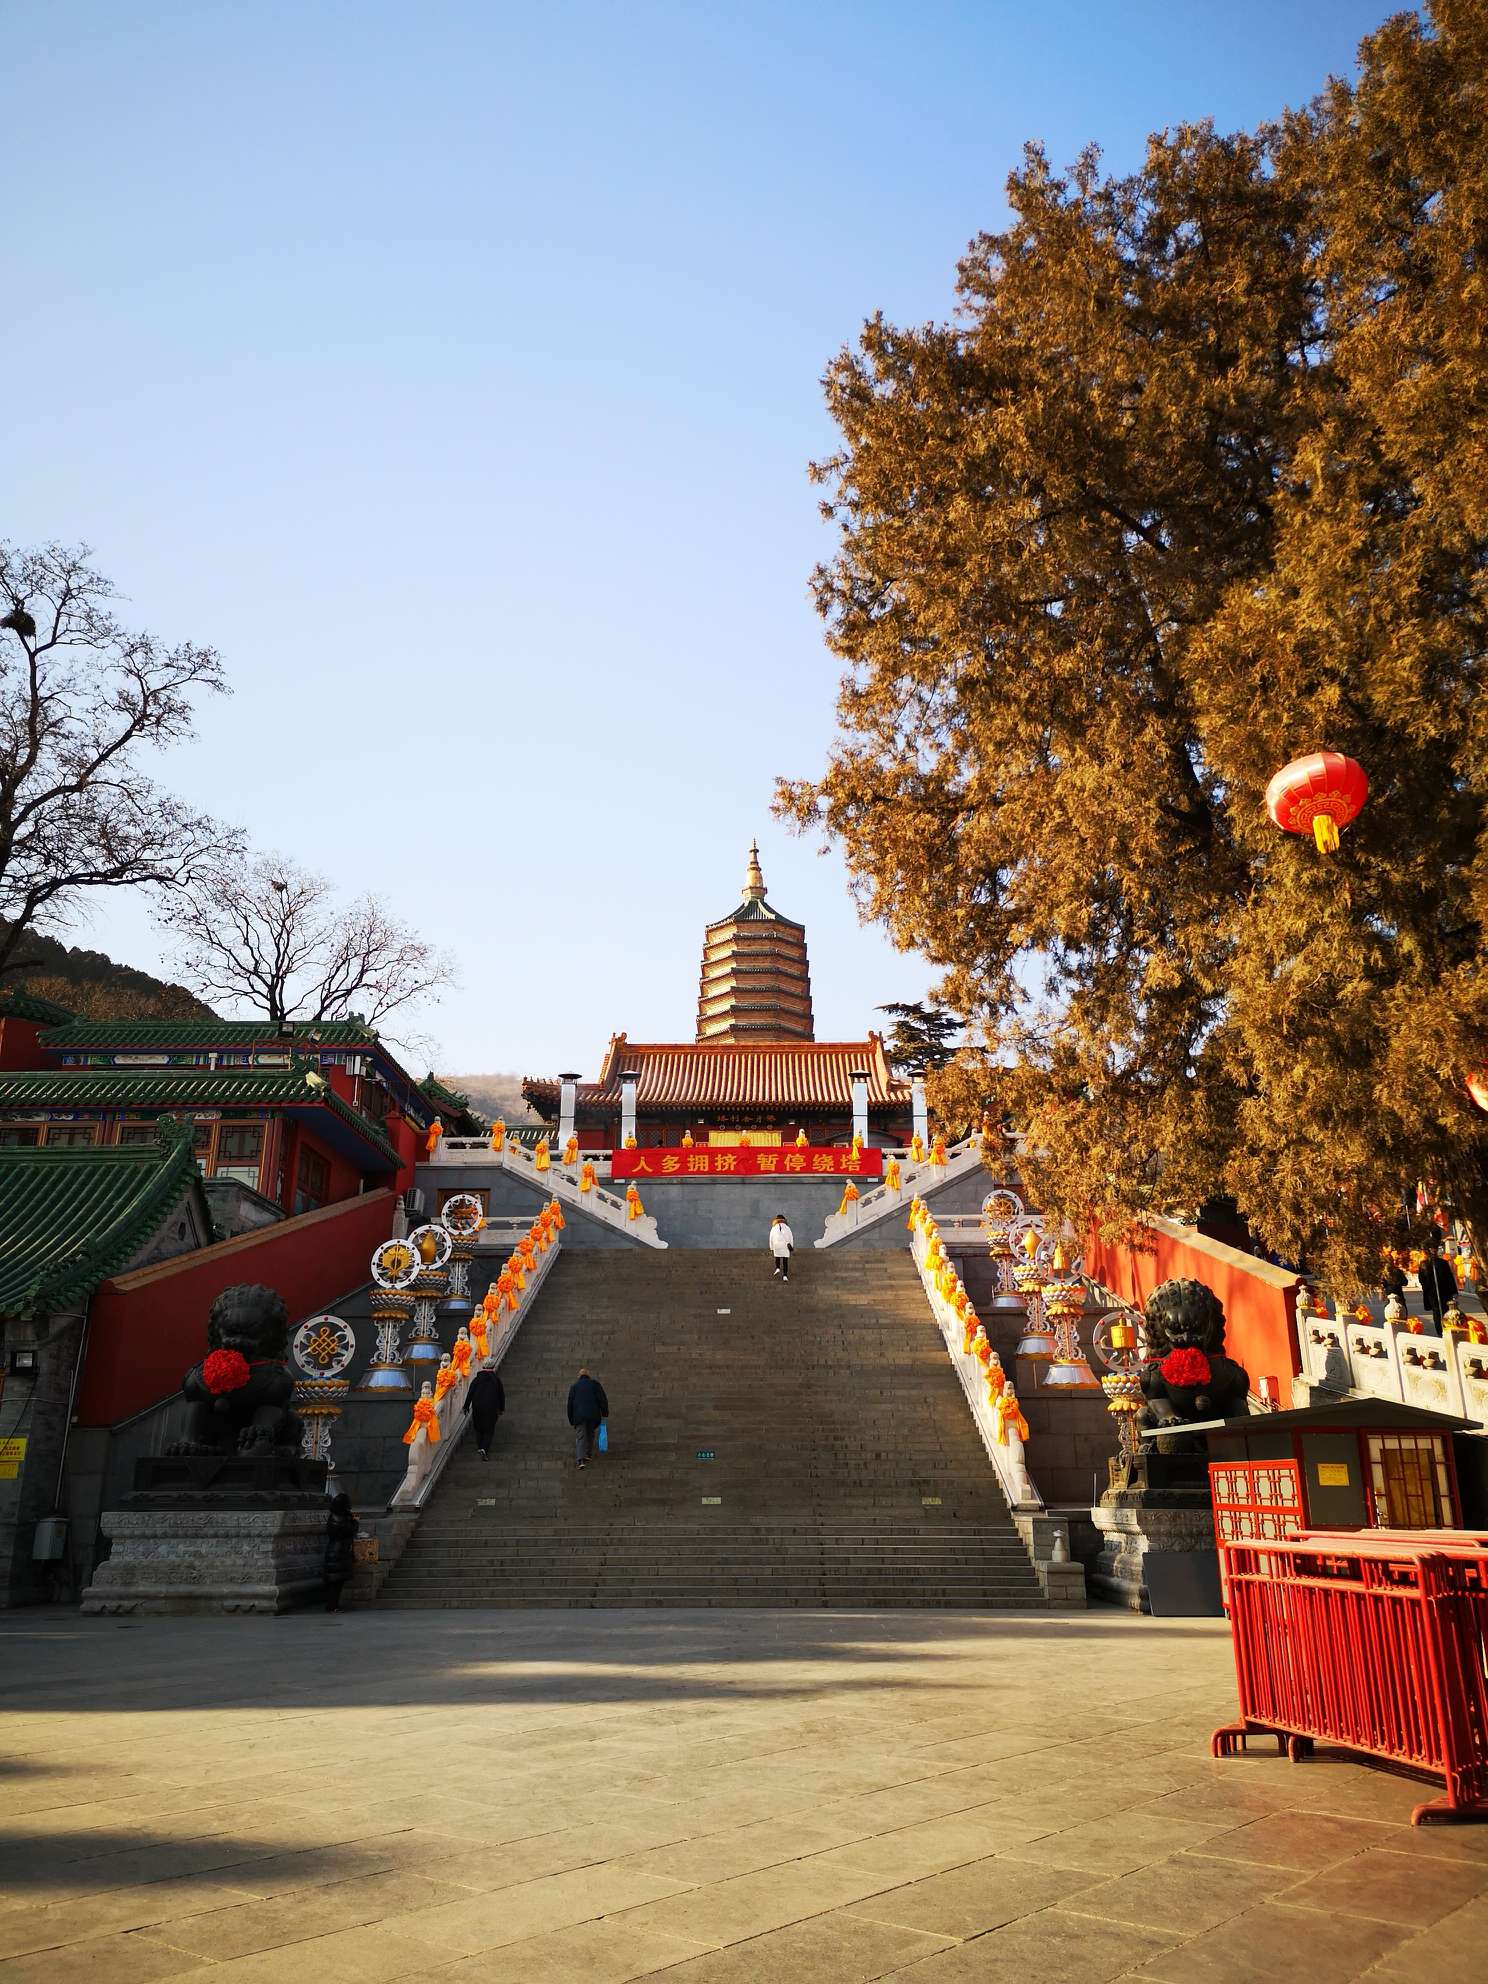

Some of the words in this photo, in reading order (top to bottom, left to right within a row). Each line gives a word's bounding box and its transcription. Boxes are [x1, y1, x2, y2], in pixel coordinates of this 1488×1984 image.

[631, 1154, 737, 1173] 人多拥挤
[756, 1153, 862, 1172] 暂停绕塔
